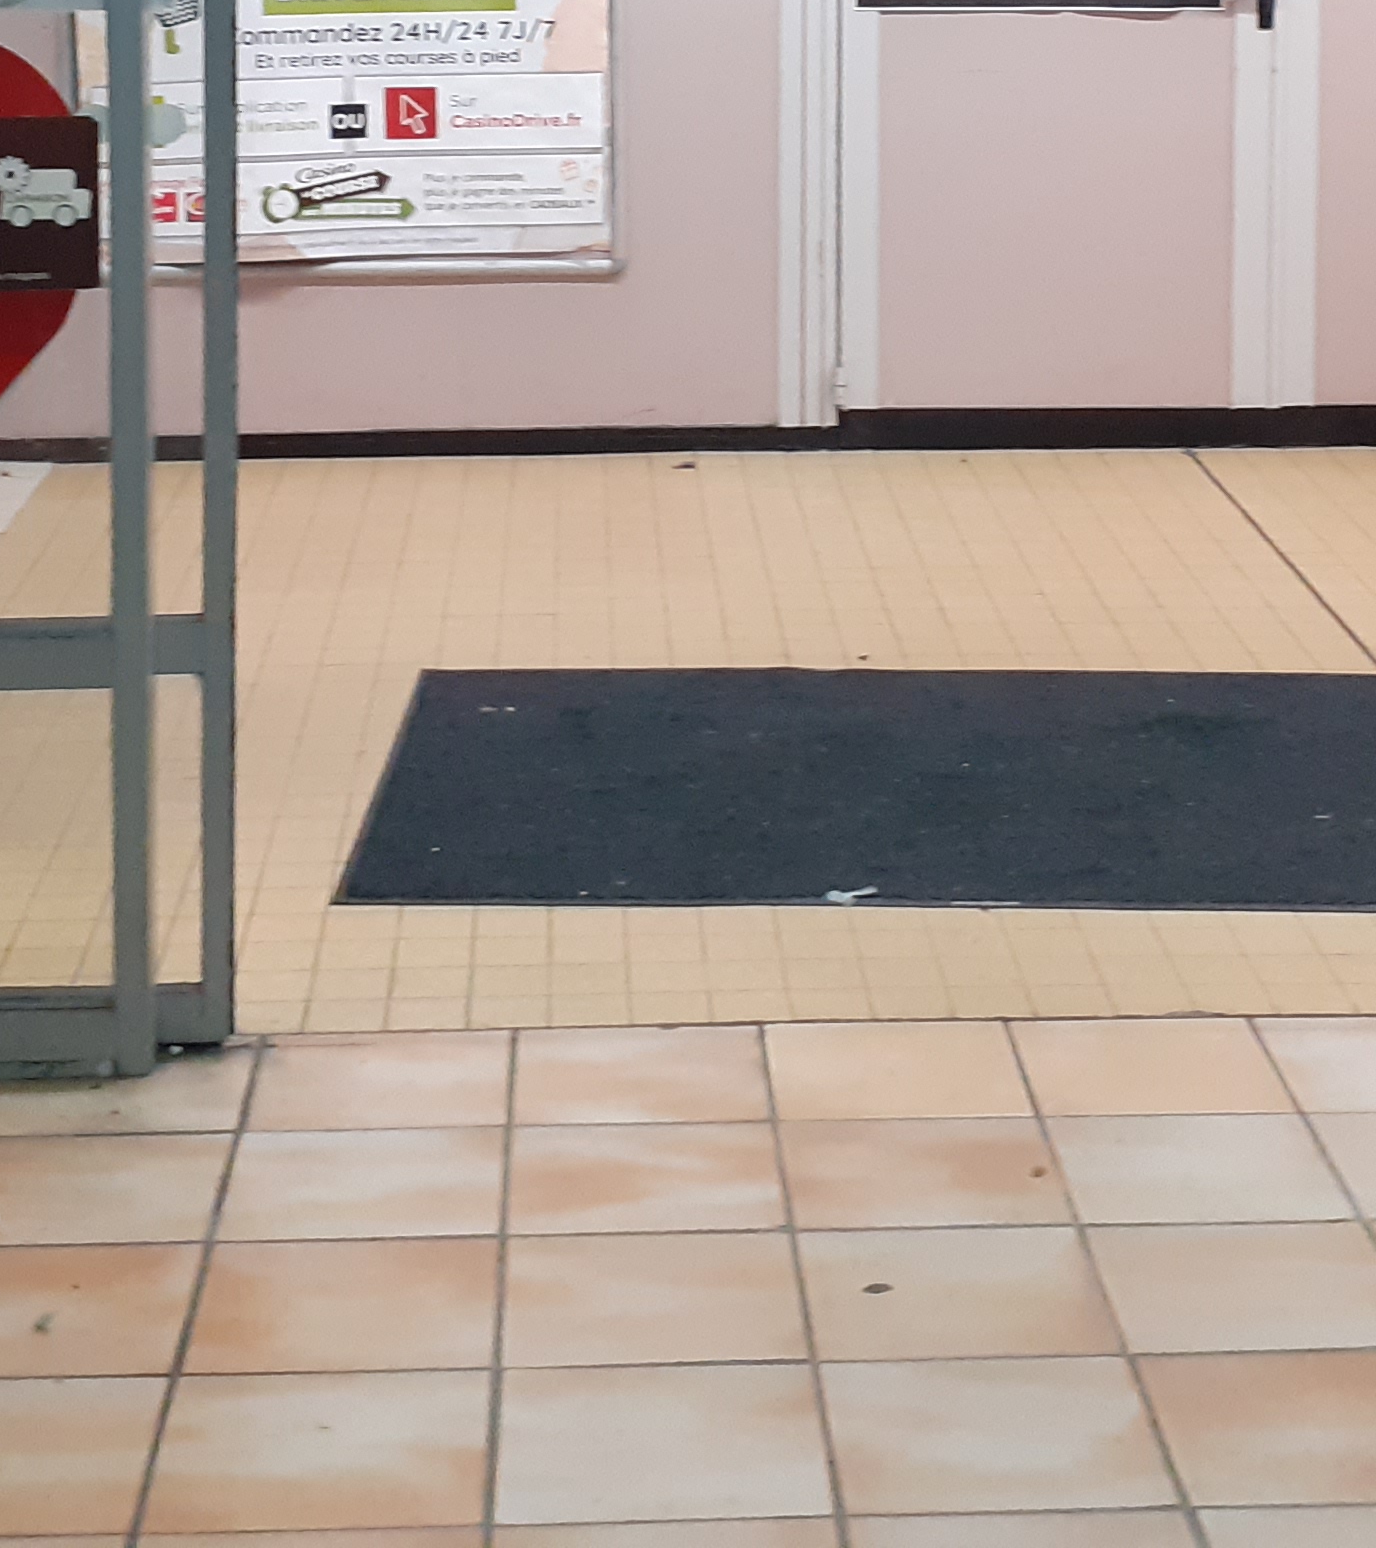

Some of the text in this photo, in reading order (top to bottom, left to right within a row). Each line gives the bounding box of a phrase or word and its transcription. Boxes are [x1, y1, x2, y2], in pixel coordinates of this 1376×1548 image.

[236, 17, 557, 45] ommandez 24H/24 7J/7
[385, 51, 460, 66] courses
[479, 48, 522, 67] pied
[333, 113, 366, 130] OU
